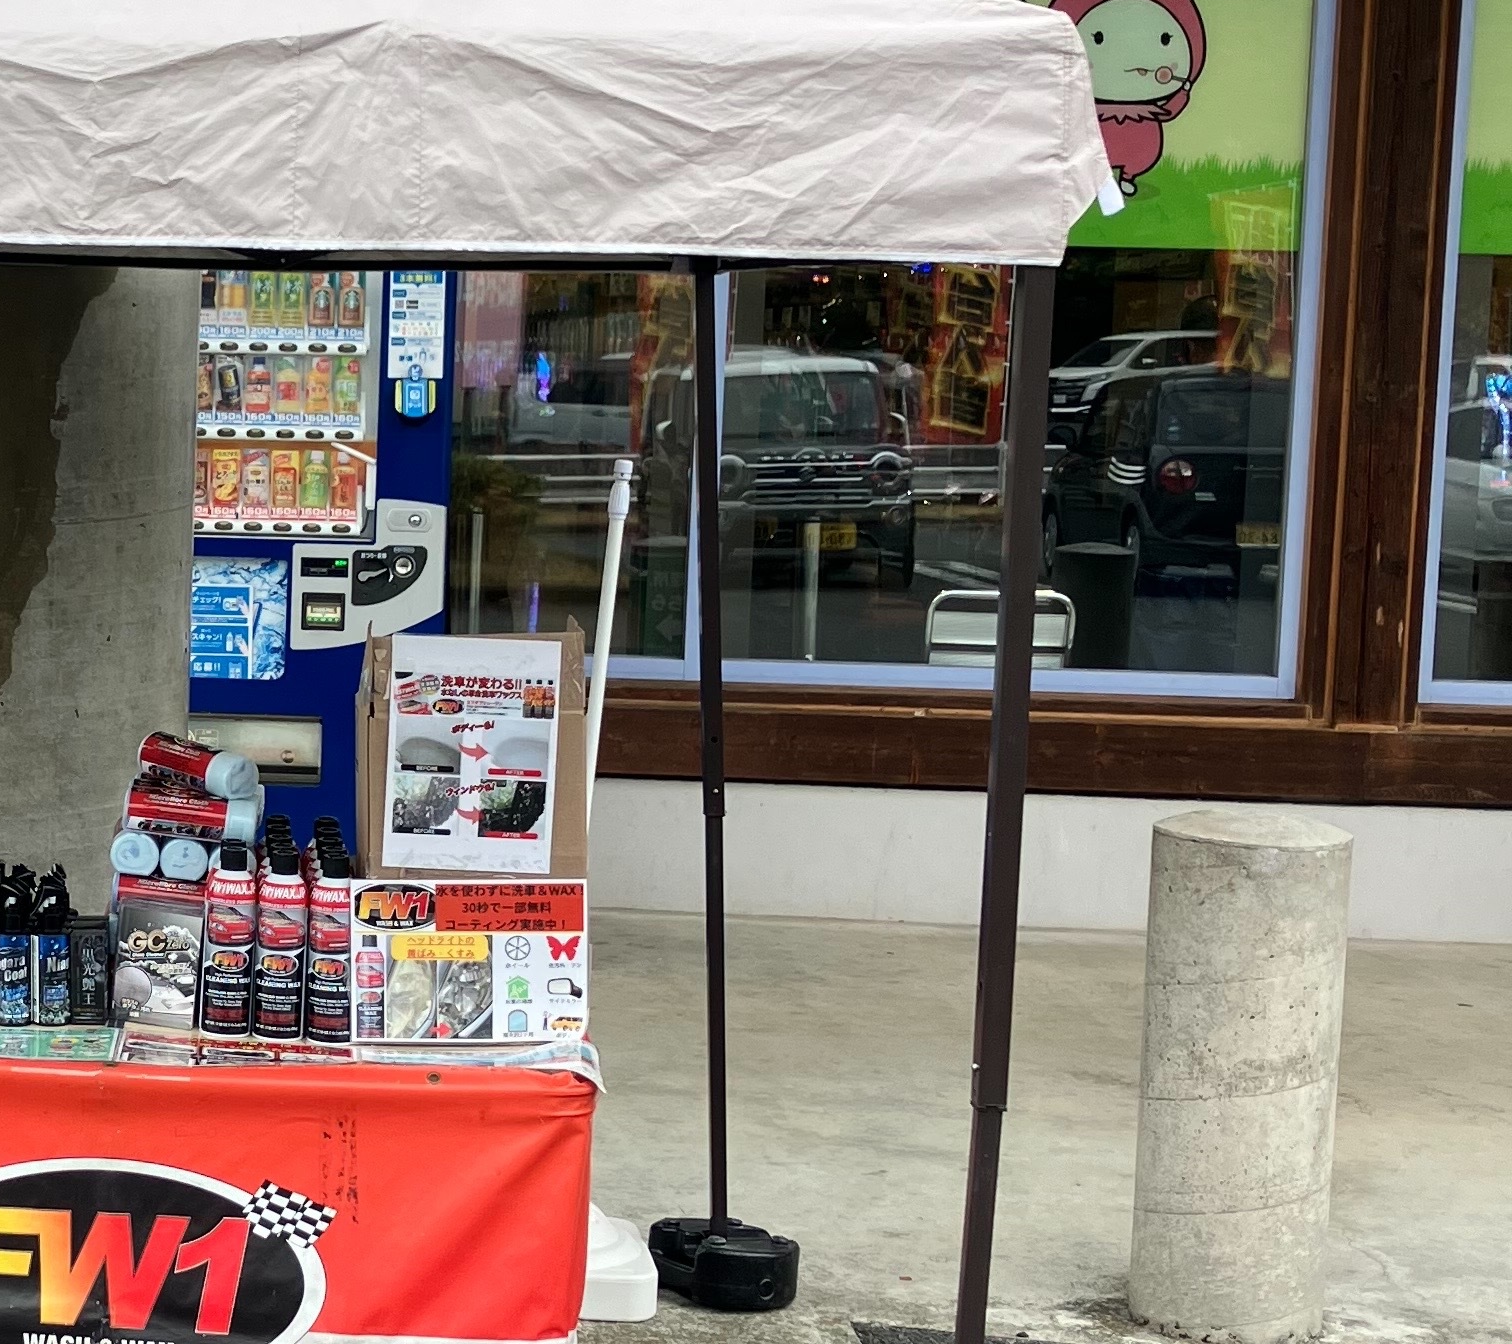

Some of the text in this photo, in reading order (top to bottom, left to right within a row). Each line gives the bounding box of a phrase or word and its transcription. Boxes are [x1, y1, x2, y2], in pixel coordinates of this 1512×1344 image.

[358, 891, 430, 920] FW1
[461, 901, 551, 914] 30秒で一部無料
[375, 919, 393, 927] WASH
[127, 929, 167, 953] GC
